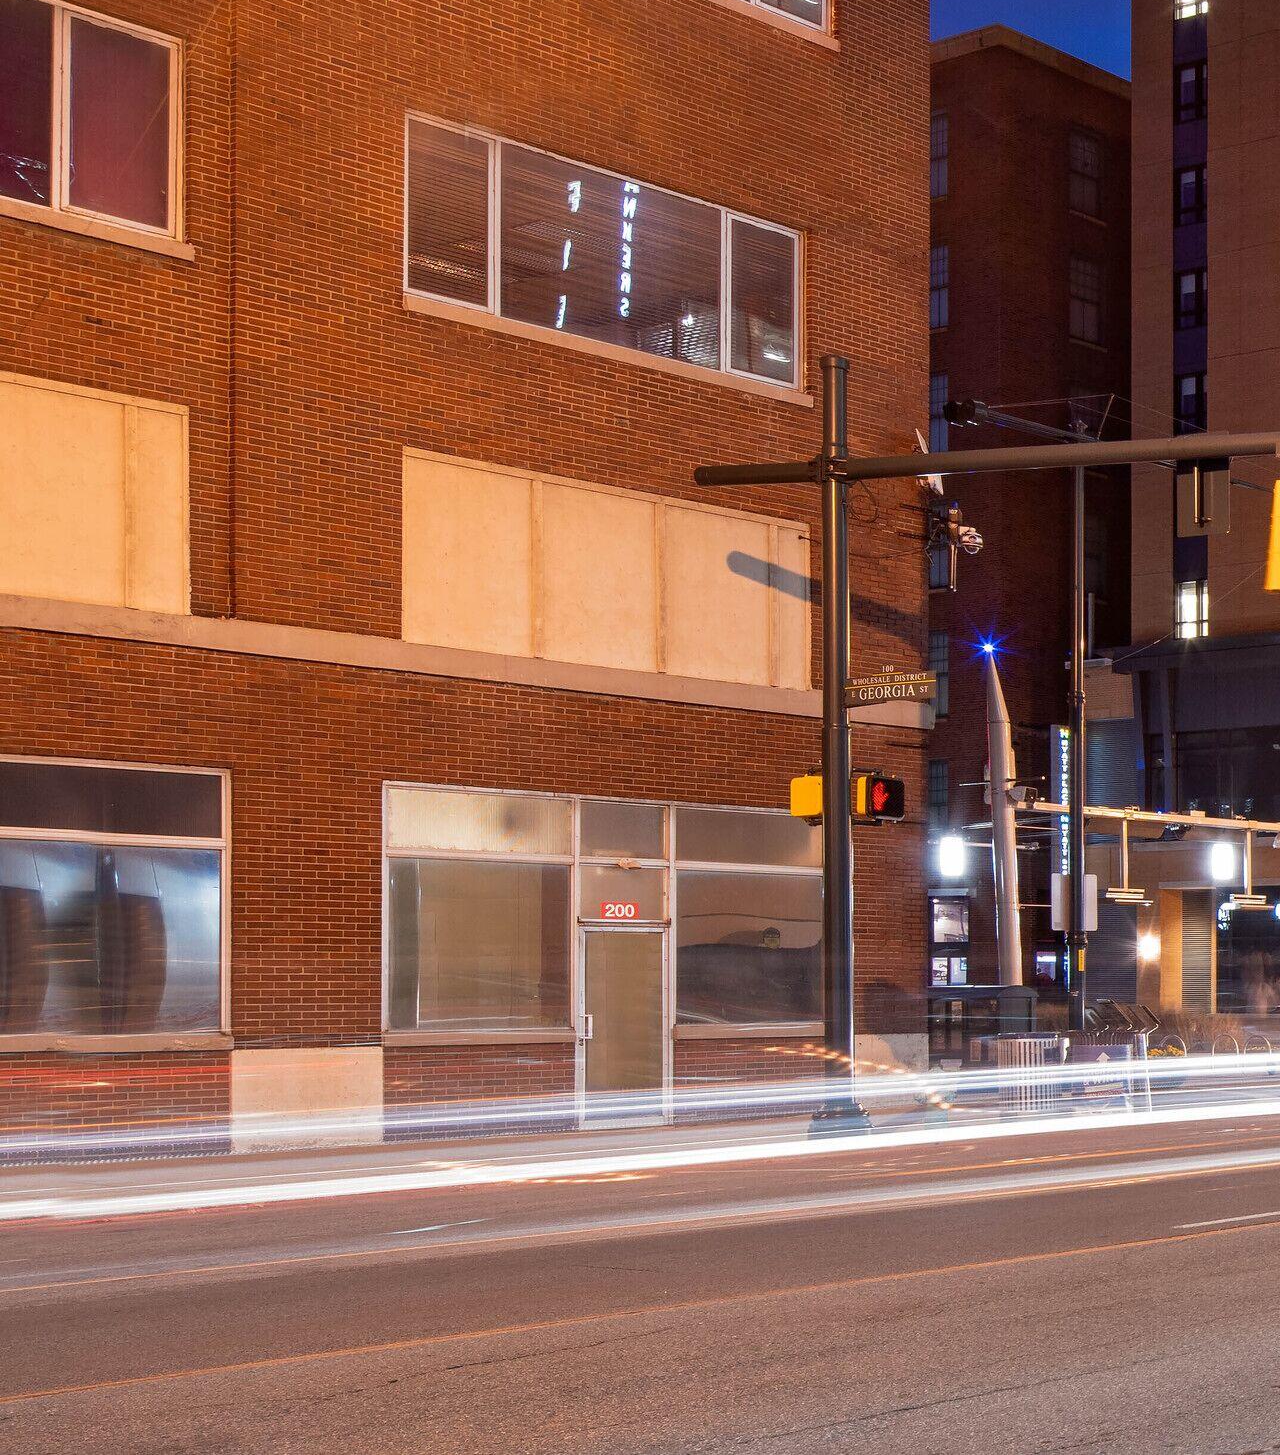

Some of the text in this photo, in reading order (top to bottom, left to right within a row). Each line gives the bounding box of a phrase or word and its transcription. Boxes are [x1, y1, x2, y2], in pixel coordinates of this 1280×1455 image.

[881, 665, 894, 673] 100
[852, 673, 927, 686] WHOLESALE DISTRICT
[851, 684, 929, 701] E GEORGIA ST
[604, 903, 635, 918] 200
